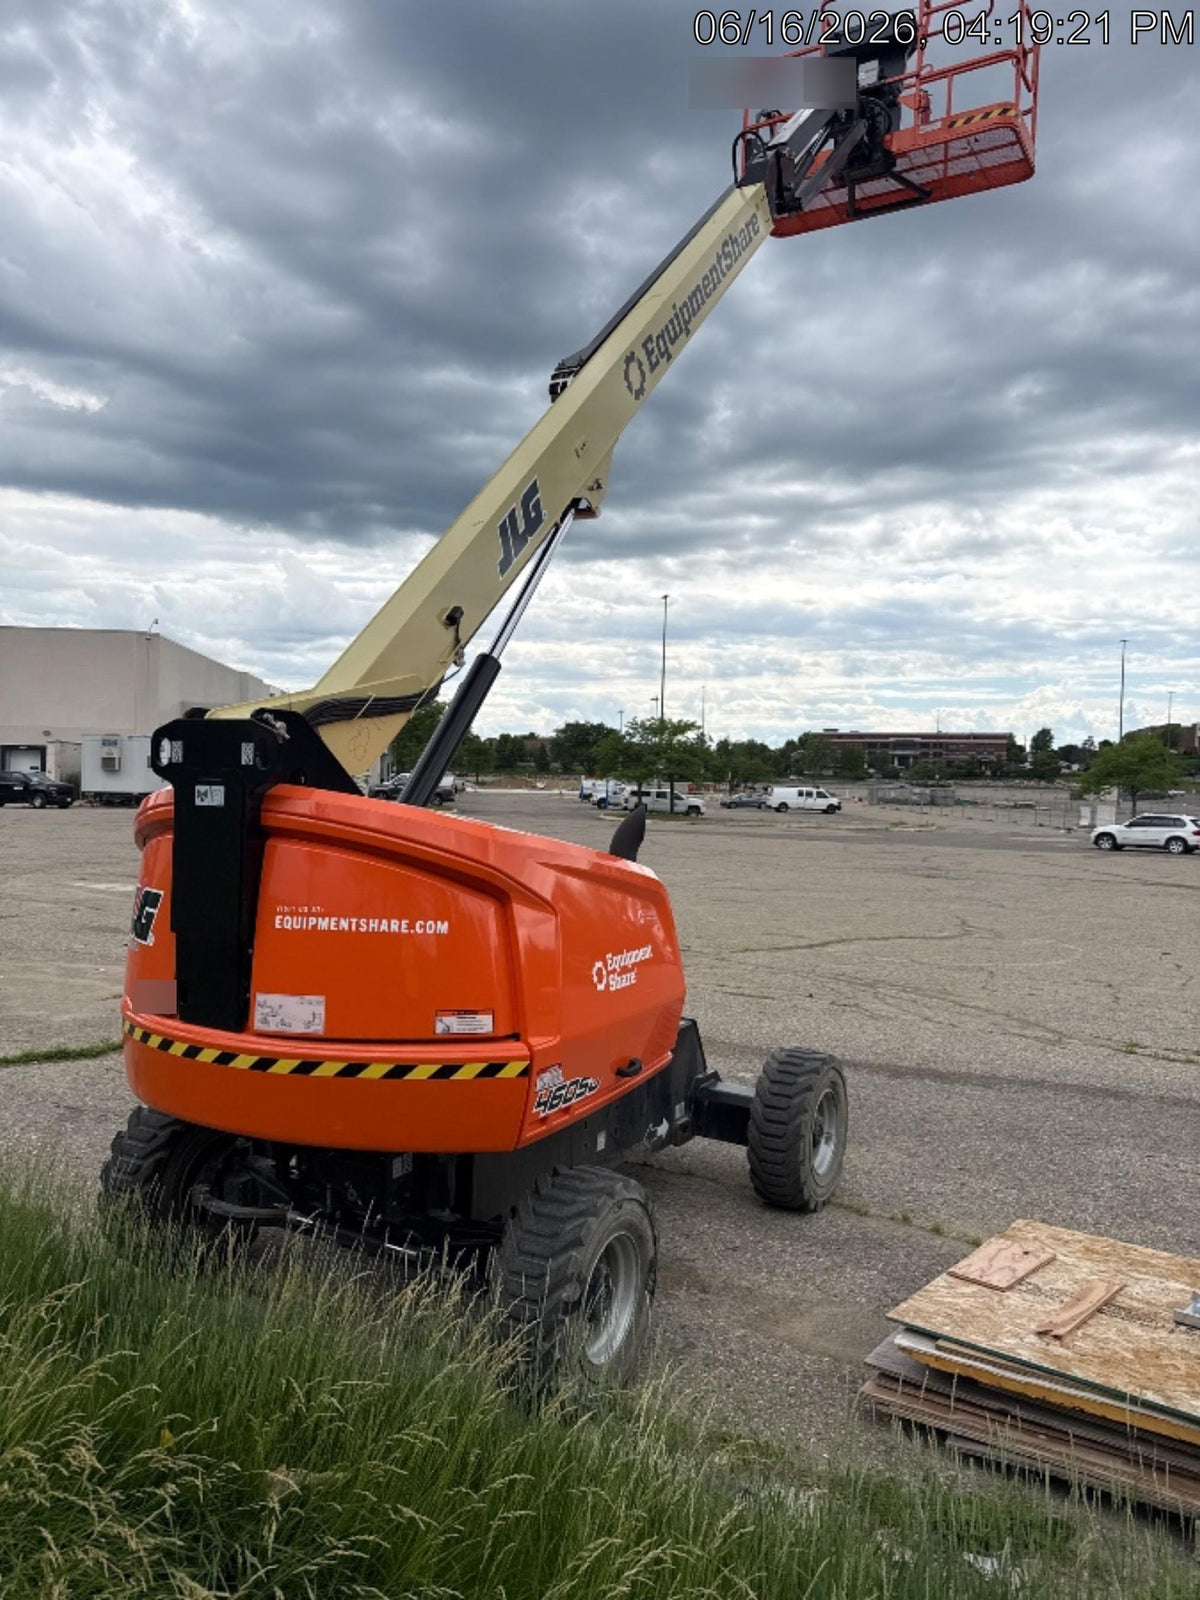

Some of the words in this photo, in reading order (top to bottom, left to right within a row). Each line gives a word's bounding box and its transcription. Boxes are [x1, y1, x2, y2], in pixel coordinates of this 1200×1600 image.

[642, 212, 760, 375] EquipmentShare
[497, 474, 544, 580] JLG
[275, 914, 449, 935] EQUIPMENTSHARE.COM
